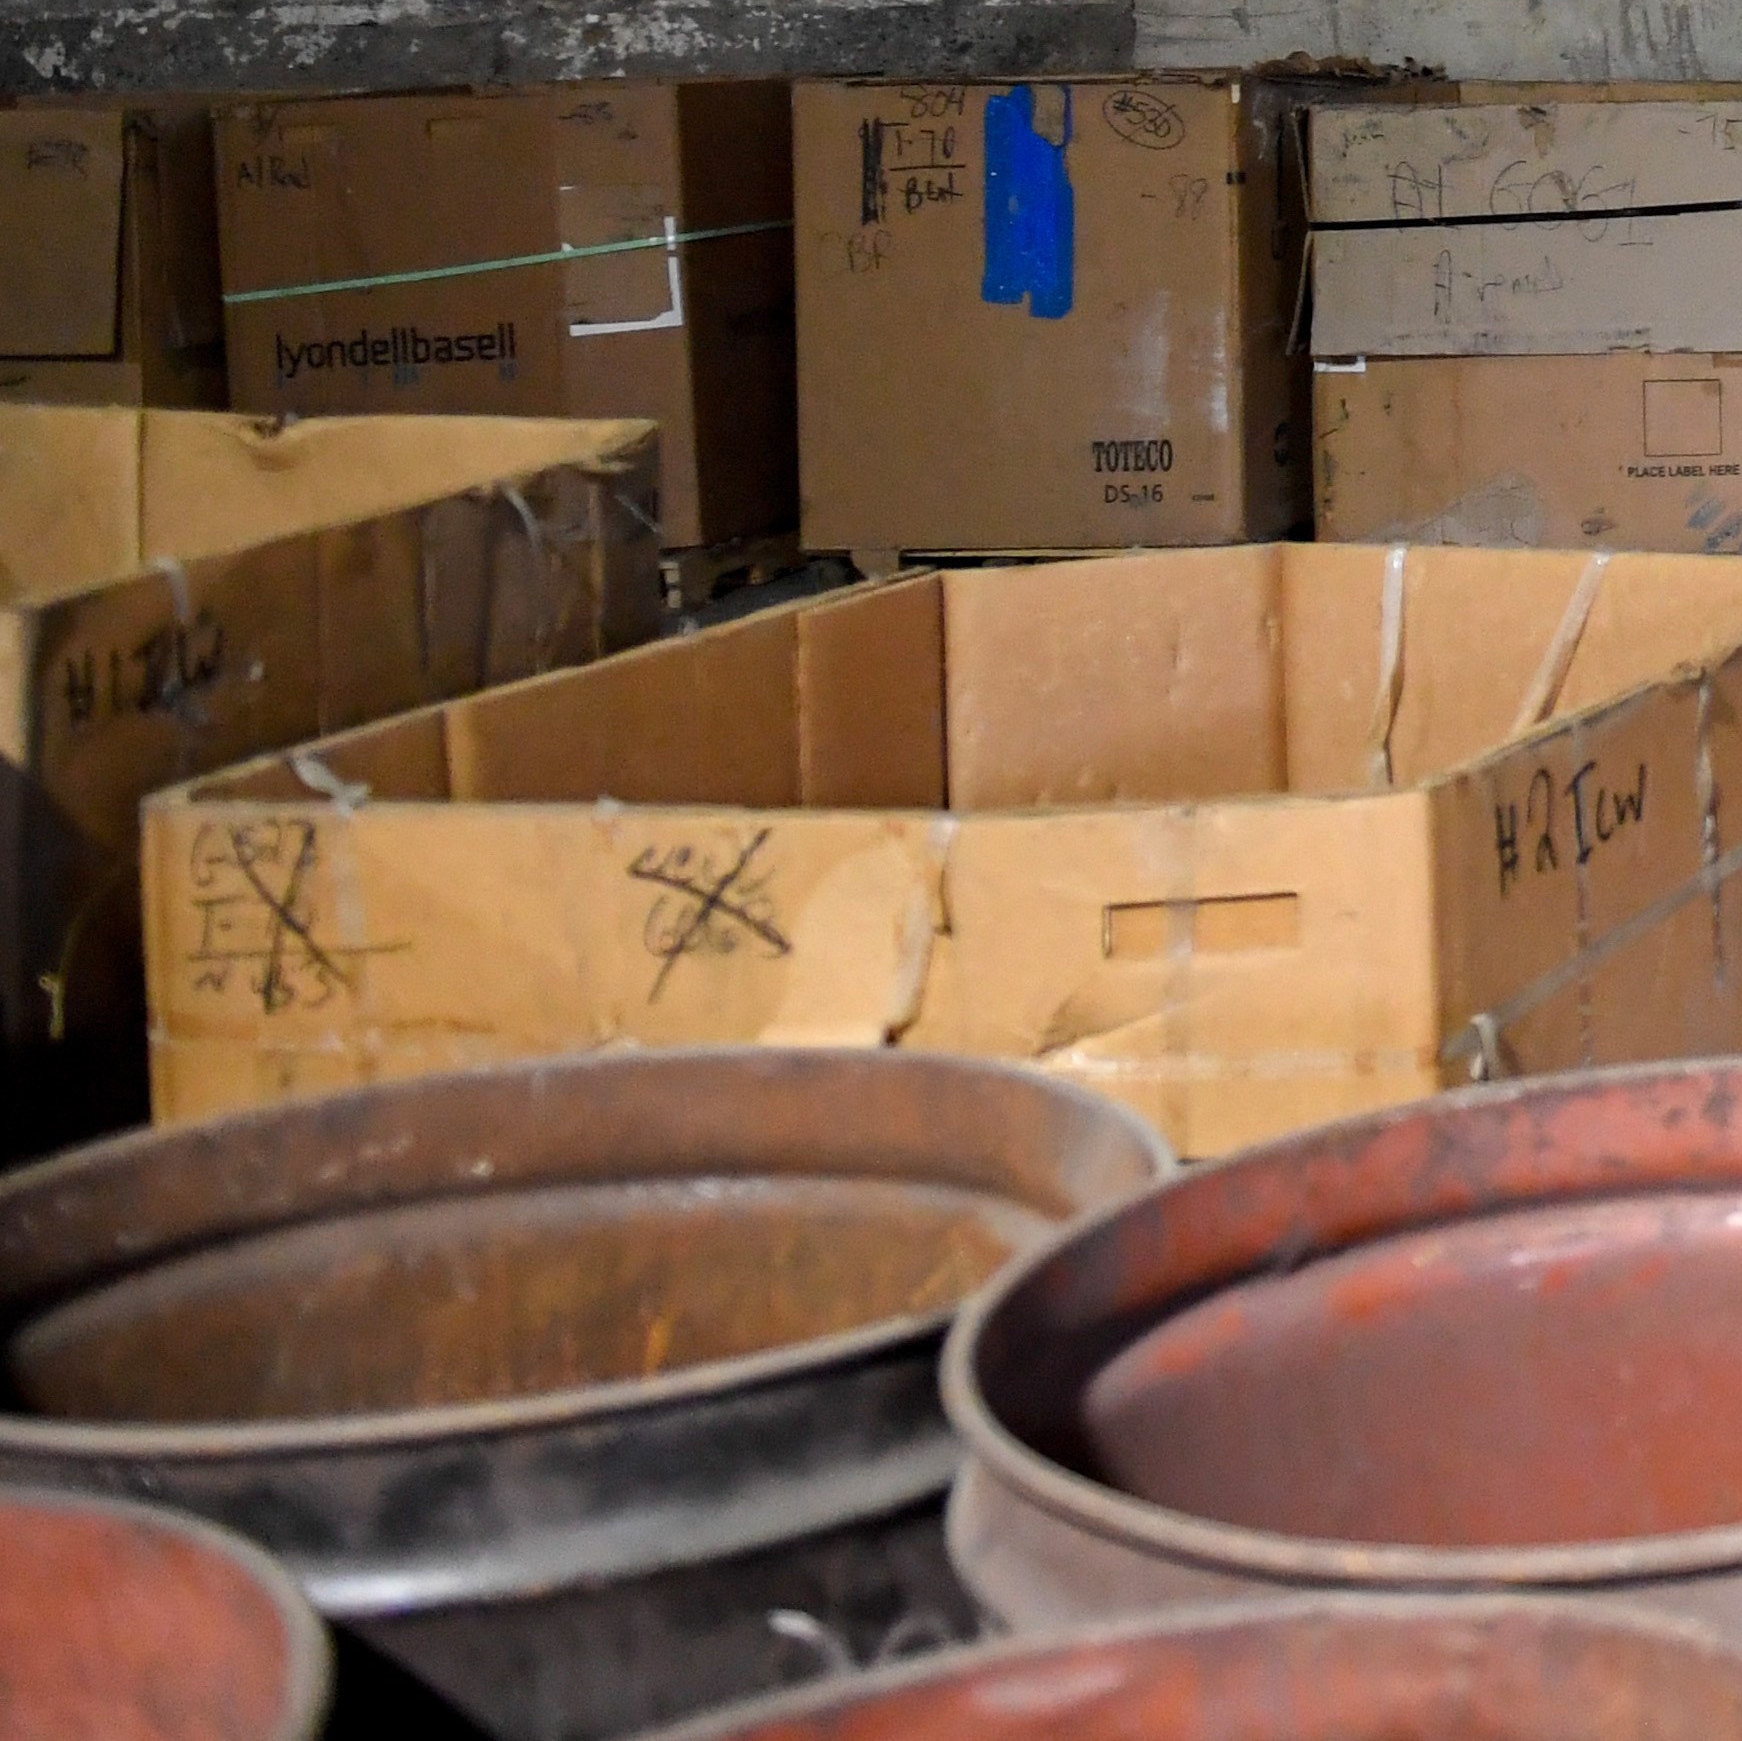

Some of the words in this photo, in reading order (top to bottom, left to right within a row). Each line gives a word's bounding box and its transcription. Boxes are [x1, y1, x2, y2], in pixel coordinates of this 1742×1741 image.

[276, 322, 516, 378] lyondellbasell
[1092, 439, 1173, 472] TOTECO
[1627, 466, 1666, 478] PLACE
[1668, 465, 1705, 477] LABEL
[1709, 464, 1740, 476] HERE
[1105, 484, 1164, 503] DS-16
